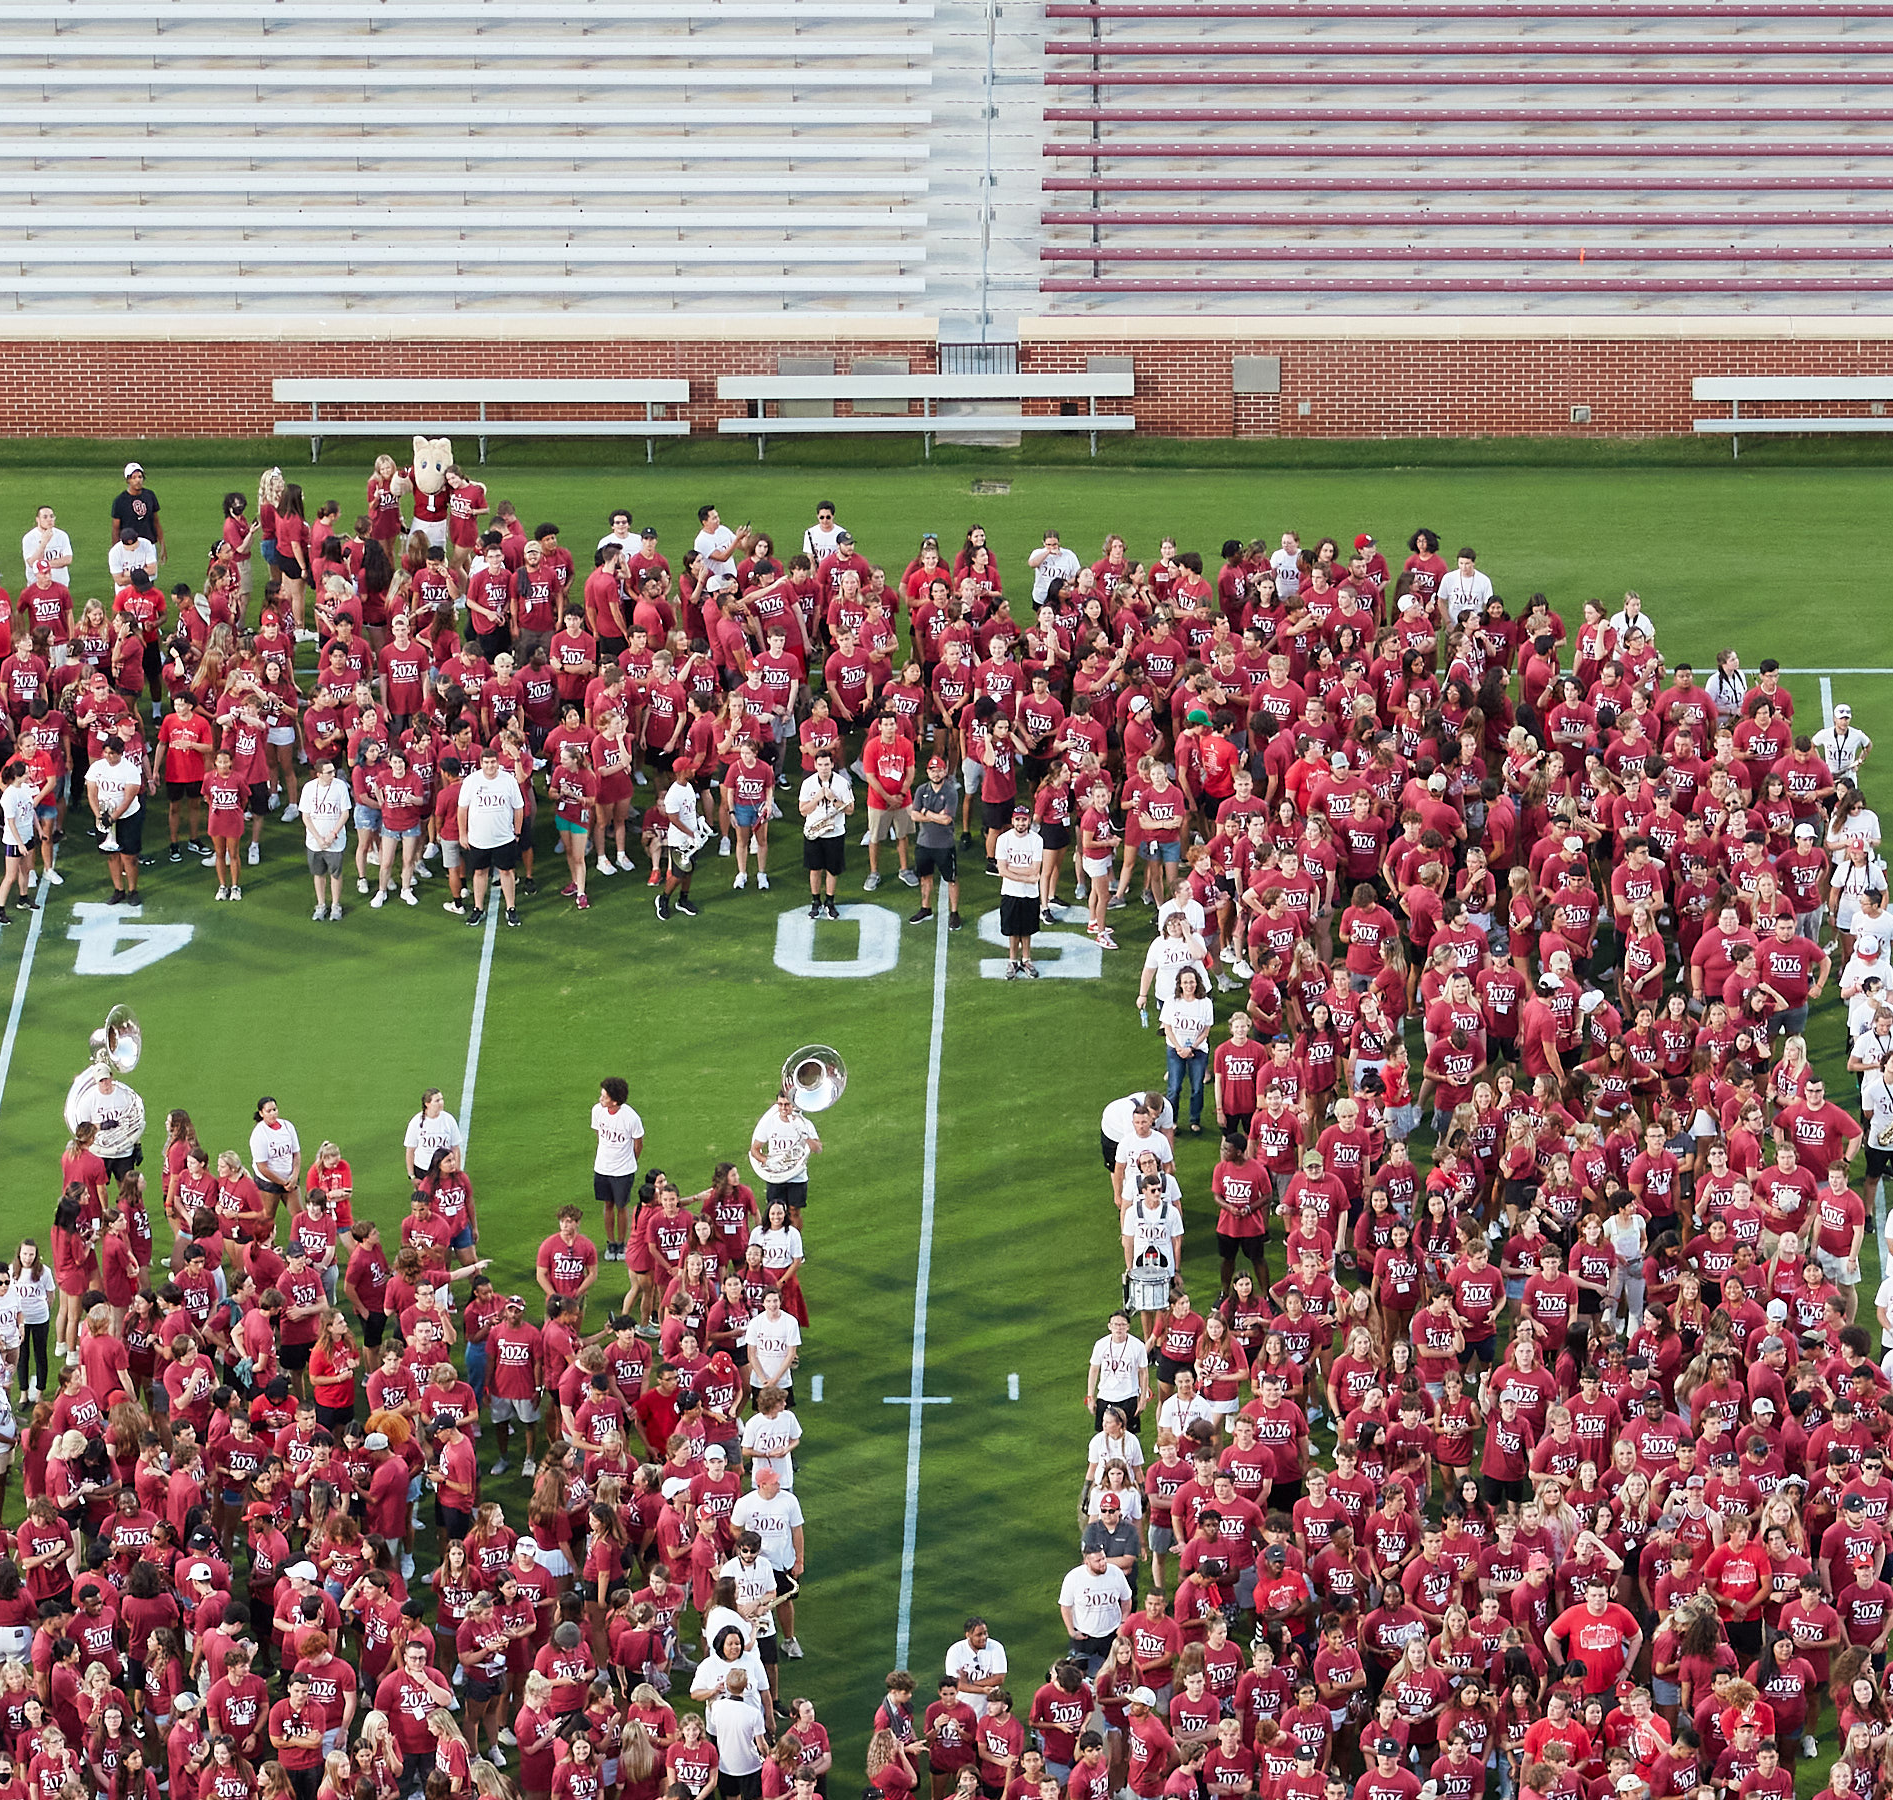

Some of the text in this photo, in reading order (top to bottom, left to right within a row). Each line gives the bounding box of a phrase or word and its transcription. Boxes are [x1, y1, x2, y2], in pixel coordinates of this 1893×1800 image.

[36, 603, 60, 614] 2026
[393, 665, 419, 677] 2026
[1147, 658, 1174, 671] 2026
[478, 795, 505, 806] 2026
[1008, 853, 1033, 865] 2026
[1770, 958, 1802, 972] 2026
[1174, 1018, 1203, 1030] 2026
[422, 1135, 449, 1148] 2026
[555, 1259, 584, 1273] 2026
[1391, 1264, 1417, 1277] 2026
[1462, 1287, 1493, 1301] 2026
[1536, 1297, 1567, 1311] 2026
[758, 1338, 787, 1352] 2026
[498, 1346, 530, 1360] 2026
[1258, 1423, 1291, 1438] 2026
[1641, 1438, 1677, 1454] 2026
[755, 1518, 783, 1530] 2026
[1086, 1593, 1116, 1606] 2026
[1855, 1605, 1883, 1618] 2026
[1053, 1707, 1083, 1721] 2026
